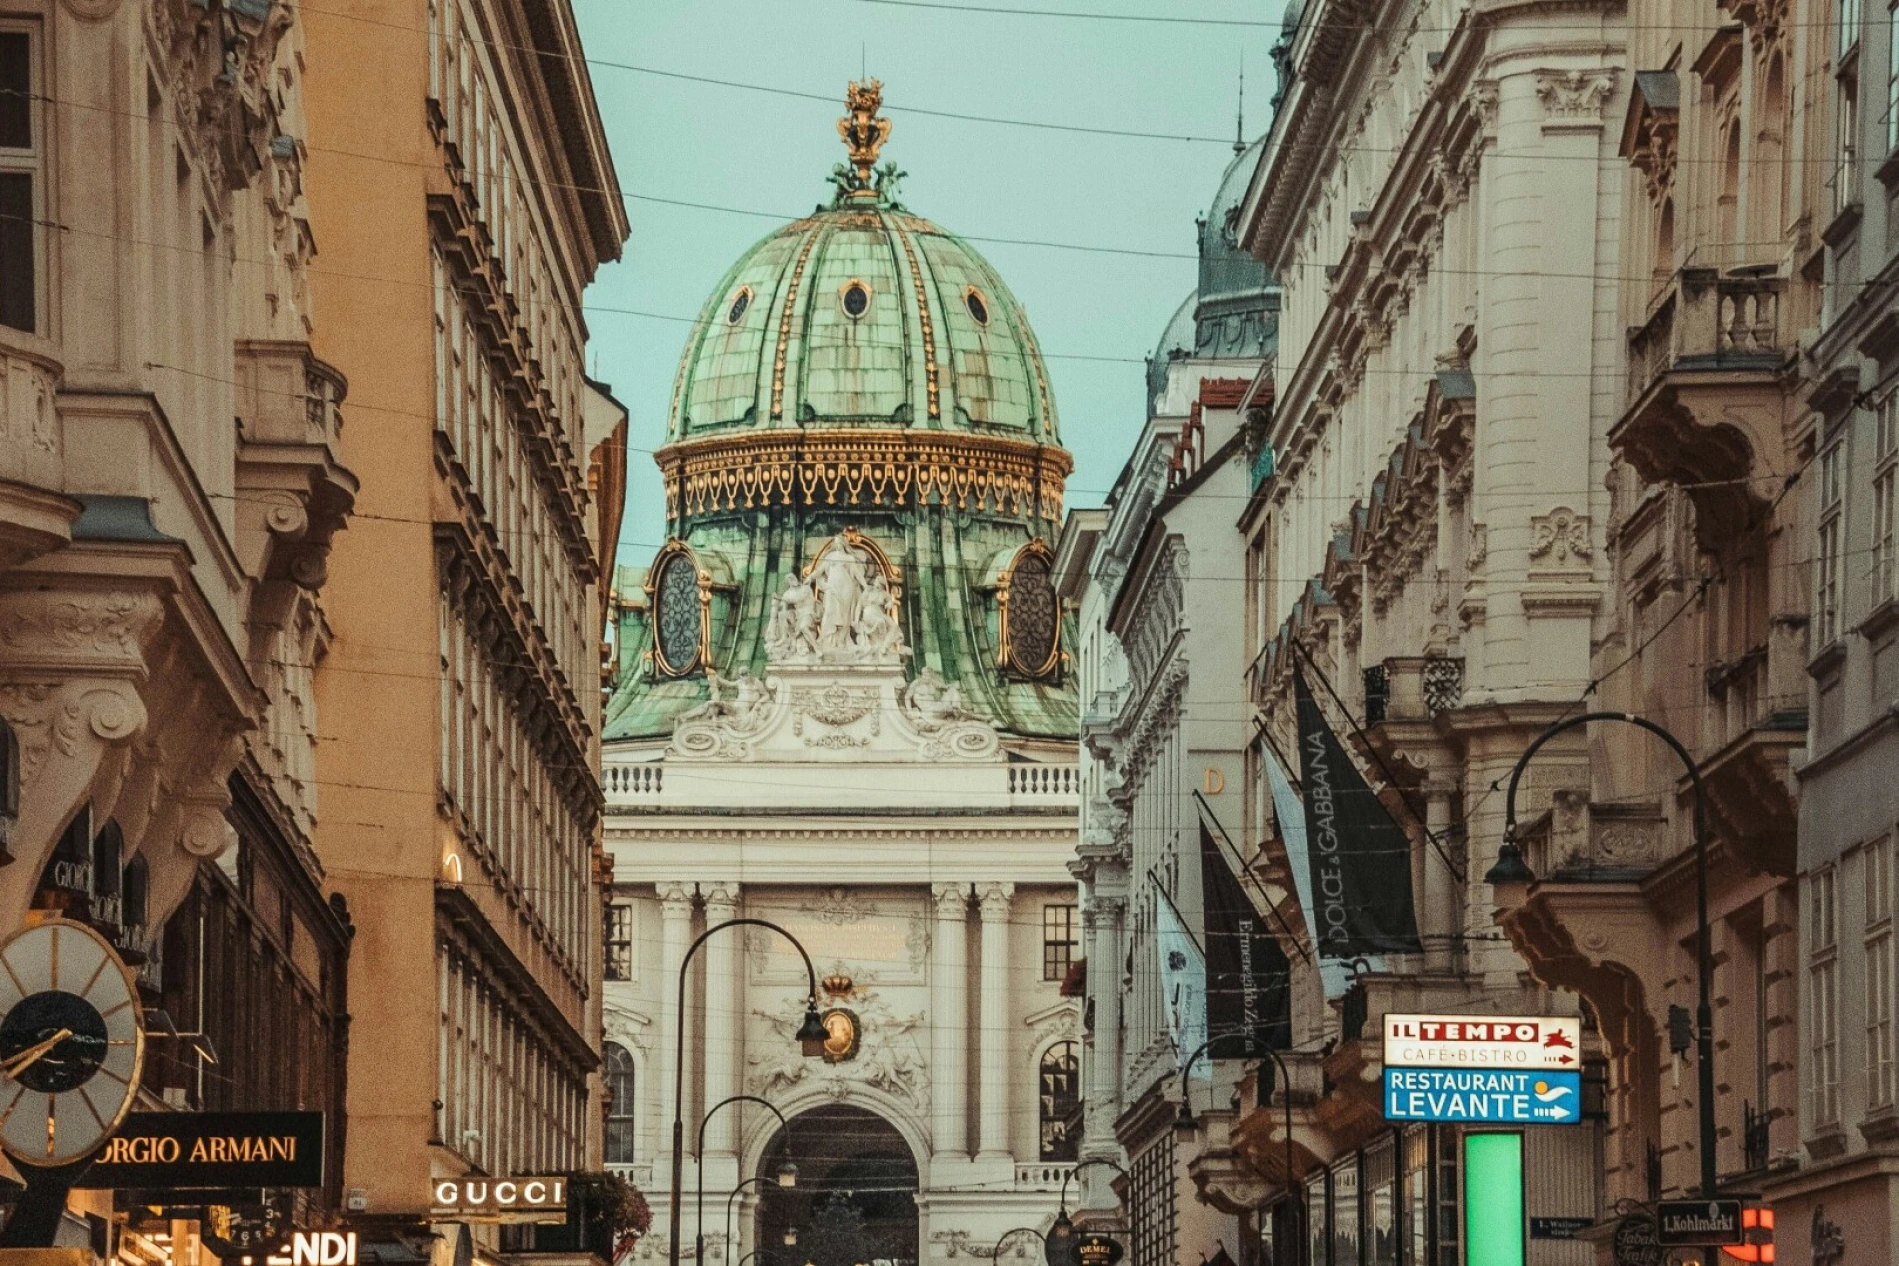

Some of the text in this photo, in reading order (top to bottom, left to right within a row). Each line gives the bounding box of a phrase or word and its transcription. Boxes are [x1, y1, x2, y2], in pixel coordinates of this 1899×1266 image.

[1307, 730, 1349, 943] DOLCE & GABBANA
[1238, 918, 1258, 1007] Ermenegildo
[1393, 1023, 1535, 1041] IL TEMPO
[1391, 1072, 1529, 1091] RESTAURANT
[1391, 1092, 1530, 1118] LEVANTE
[189, 1136, 297, 1162] ARMANI
[436, 1182, 562, 1204] GUCCI
[1673, 1214, 1734, 1232] Kohlmarkt
[243, 1231, 358, 1266] NDI
